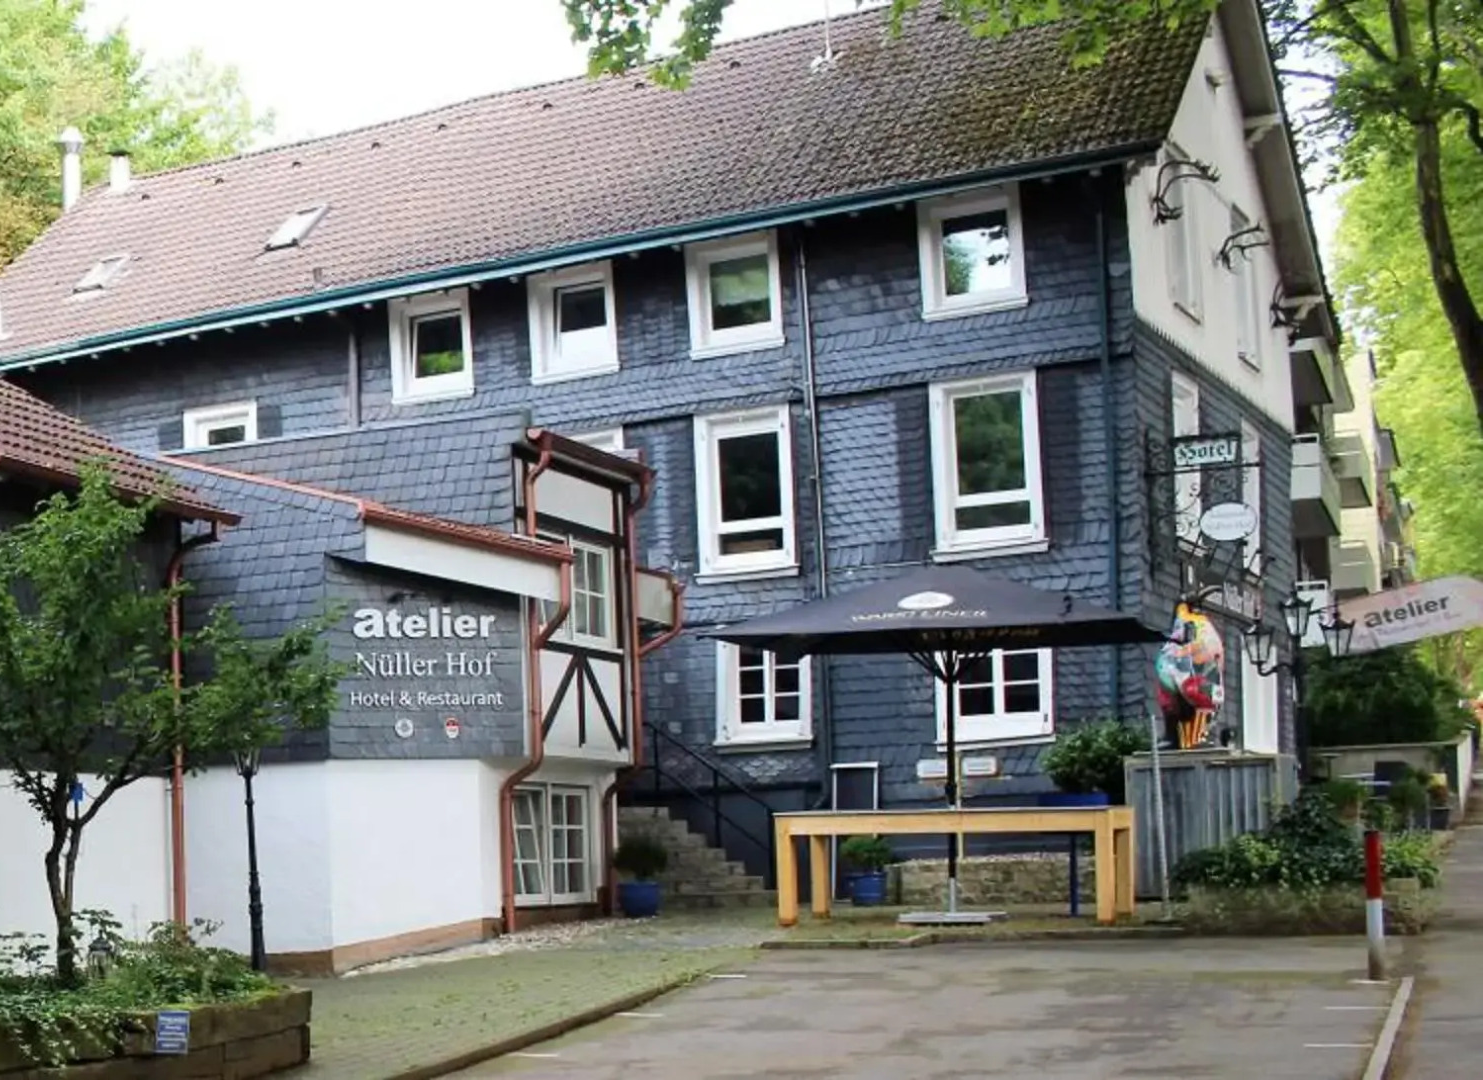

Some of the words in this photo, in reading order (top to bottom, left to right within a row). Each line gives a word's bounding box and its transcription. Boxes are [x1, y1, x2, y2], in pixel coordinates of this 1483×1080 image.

[1179, 438, 1233, 460] Hotel
[353, 607, 495, 638] atelier
[1364, 596, 1449, 628] atelier
[355, 652, 438, 676] Nüller
[446, 652, 497, 676] Hof
[350, 690, 394, 707] Hotel
[398, 691, 413, 707] &
[417, 690, 503, 706] Restaurant
